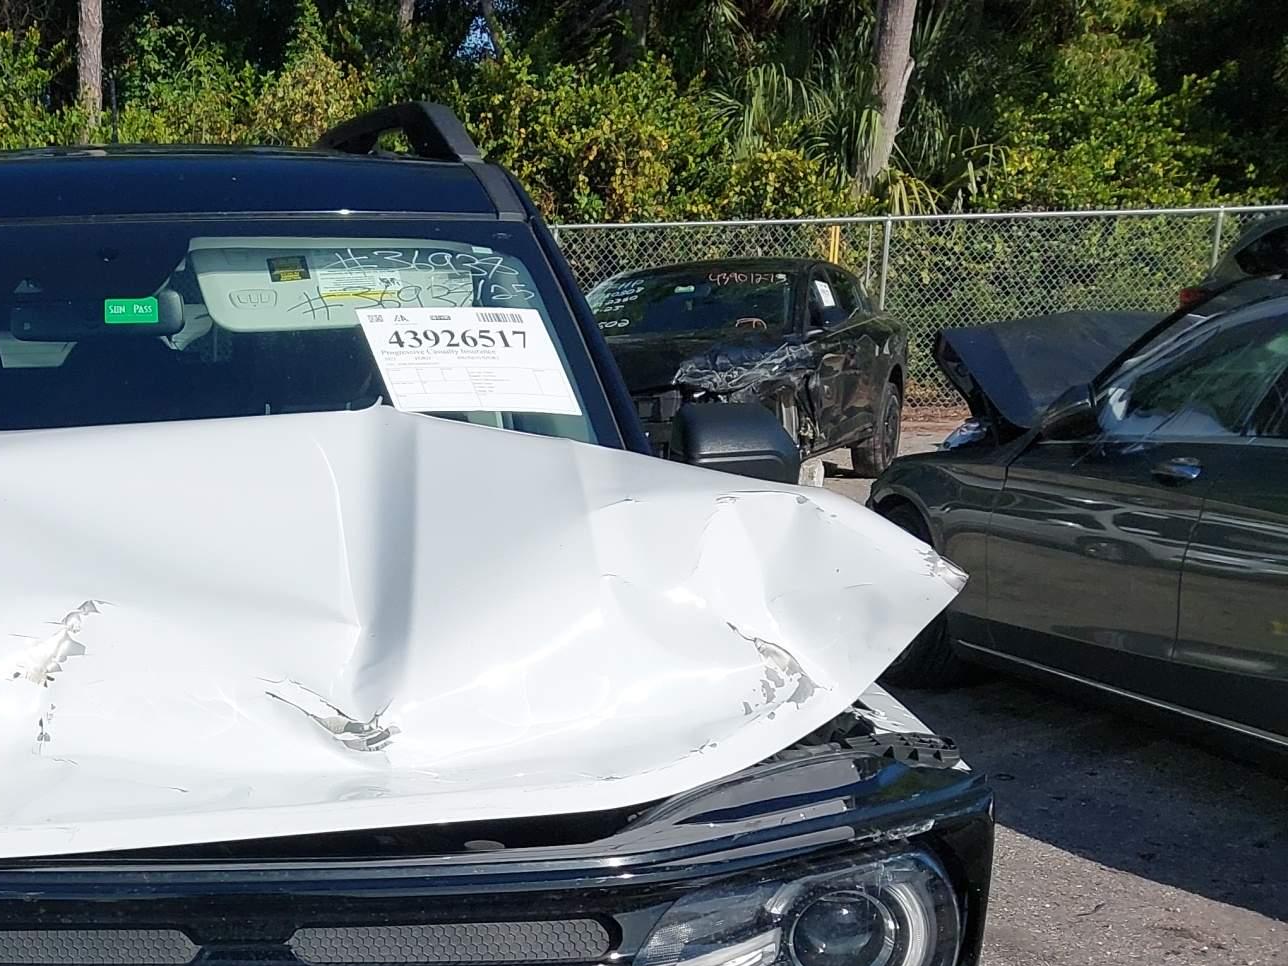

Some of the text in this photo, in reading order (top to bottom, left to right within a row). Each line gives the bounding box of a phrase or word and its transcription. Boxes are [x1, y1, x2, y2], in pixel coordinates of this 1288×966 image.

[108, 303, 153, 315] SUN PASS
[388, 328, 527, 349] 43926517
